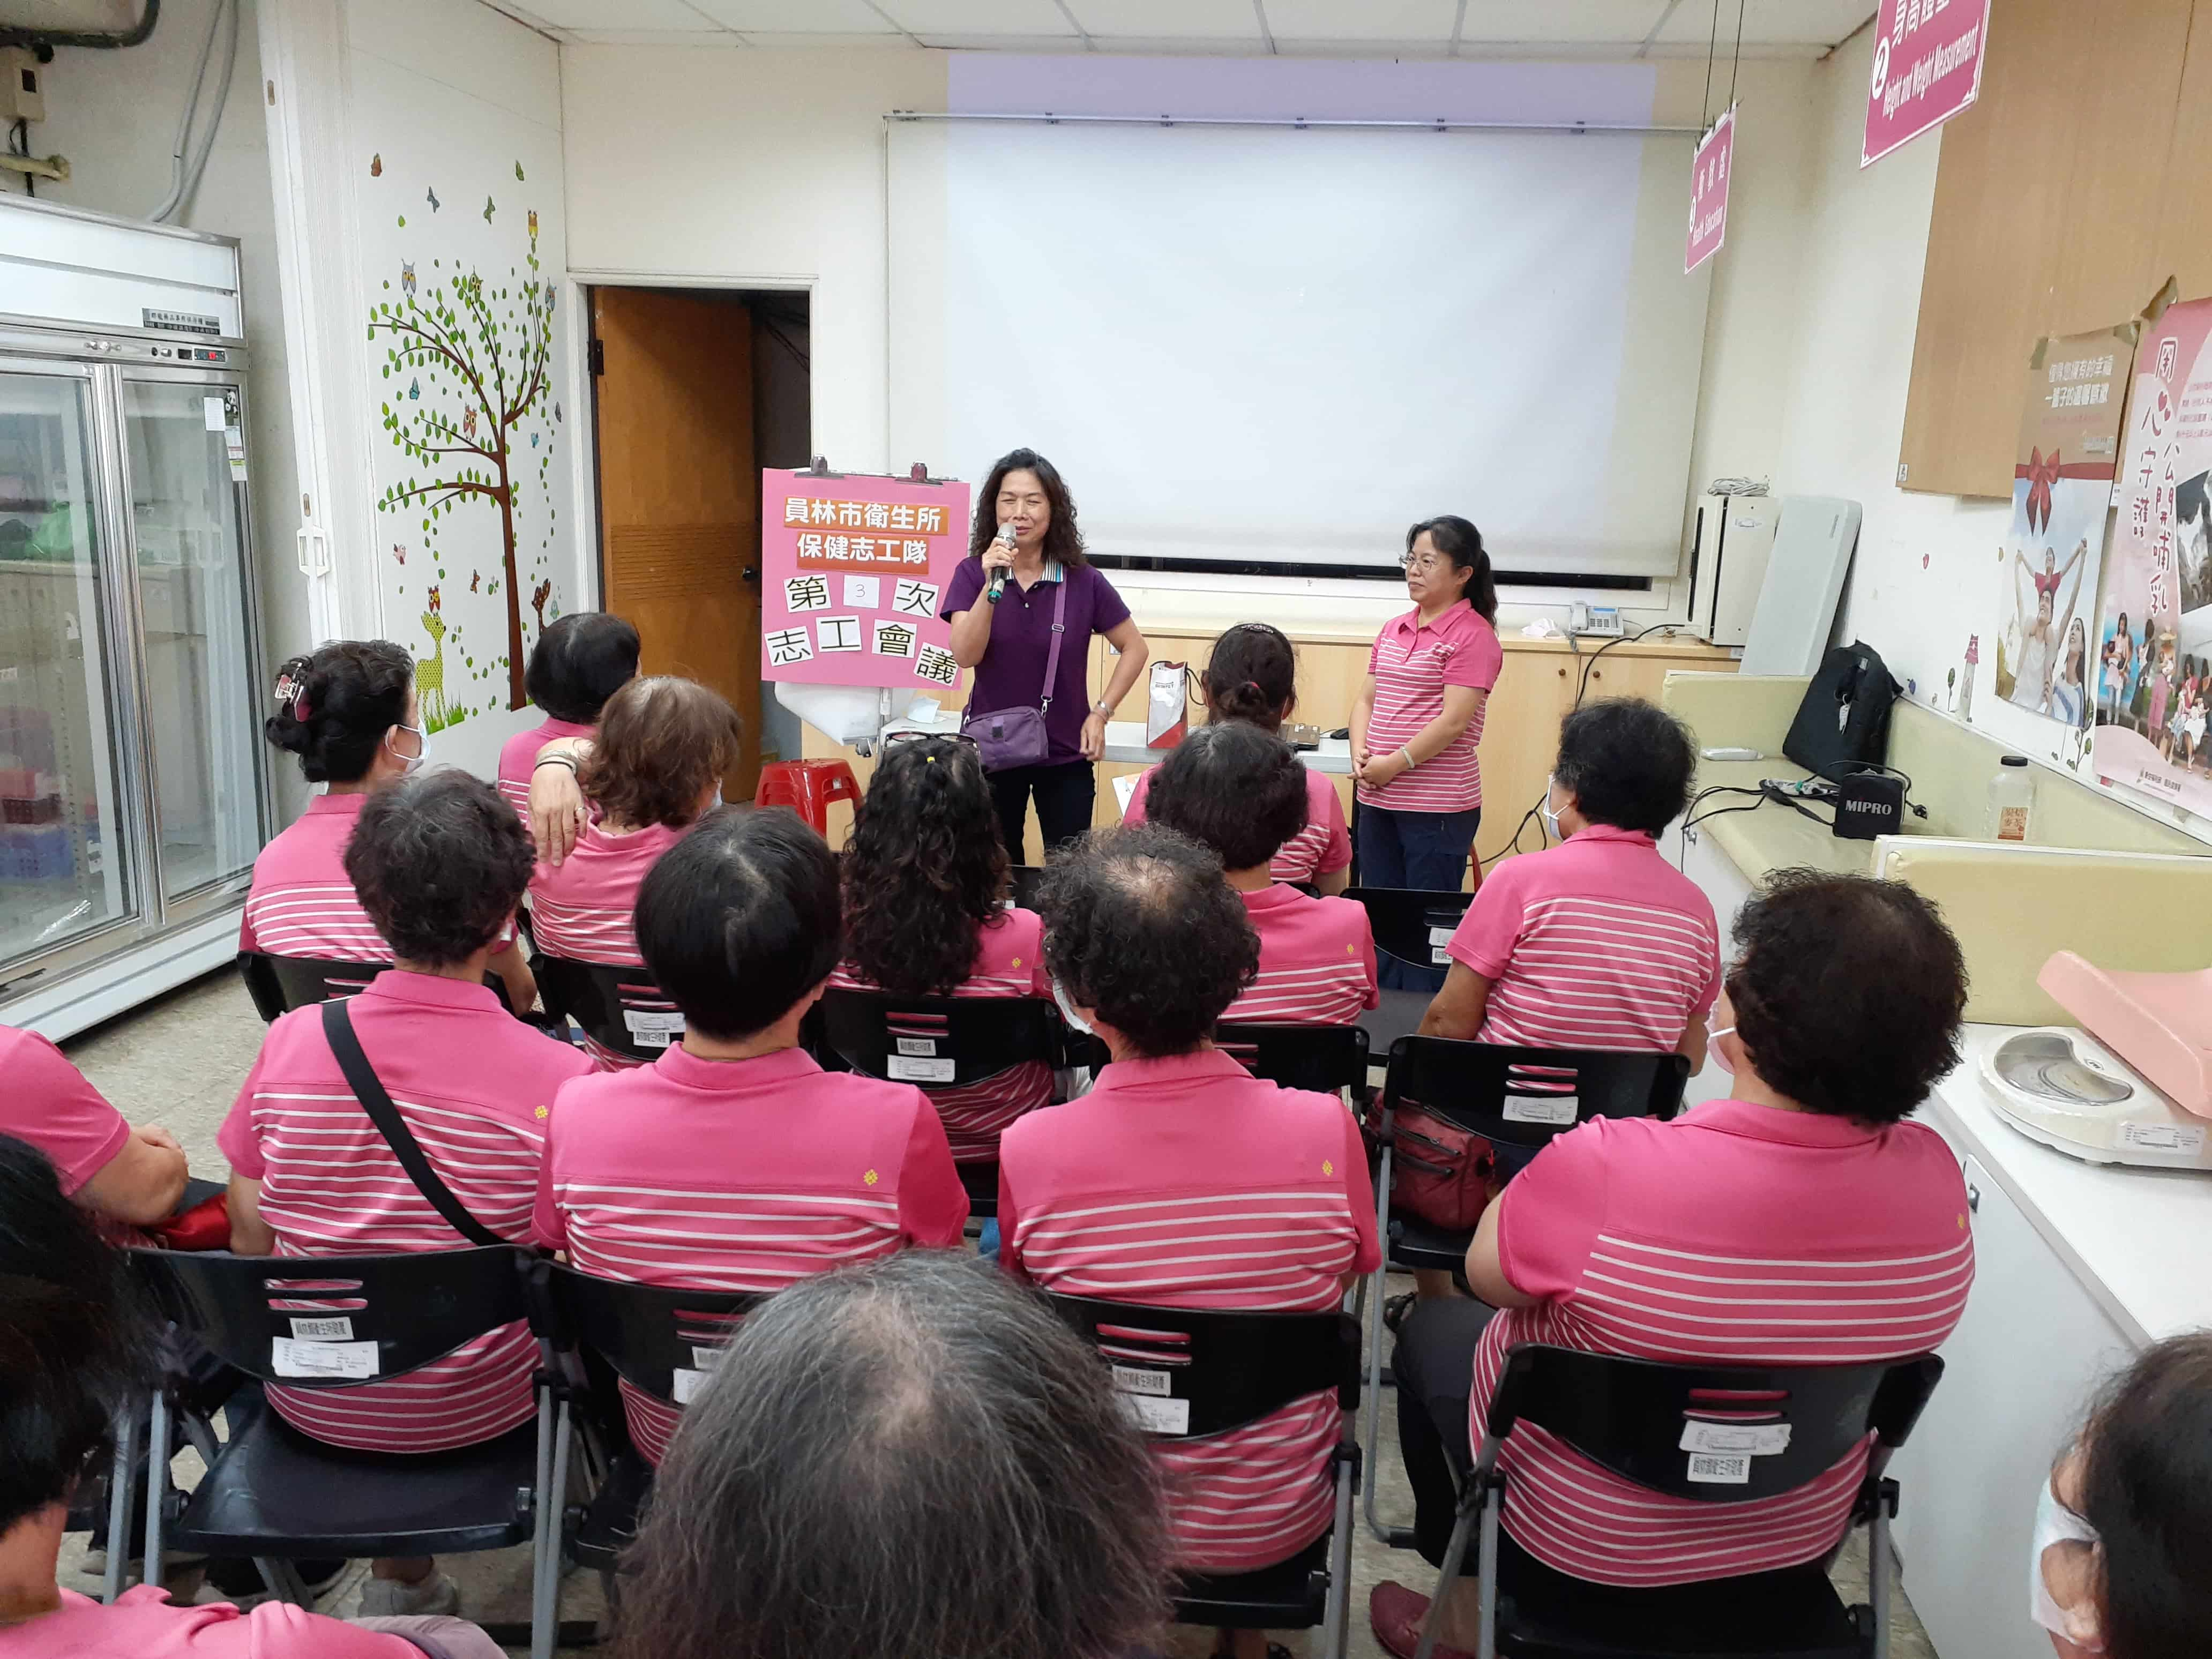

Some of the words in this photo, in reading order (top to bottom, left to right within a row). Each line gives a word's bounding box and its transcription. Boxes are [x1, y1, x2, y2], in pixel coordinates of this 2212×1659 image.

[1892, 0, 1950, 49] 身高
[1882, 74, 1902, 120] Height
[1901, 63, 1914, 105] and
[1912, 50, 1934, 100] Weight
[1932, 17, 1979, 84] Measurement
[784, 497, 941, 532] 員林市衛生所
[797, 533, 927, 564] 保健志工隊
[767, 618, 957, 684] 志工會議
[1845, 799, 1892, 815] MIPRO
